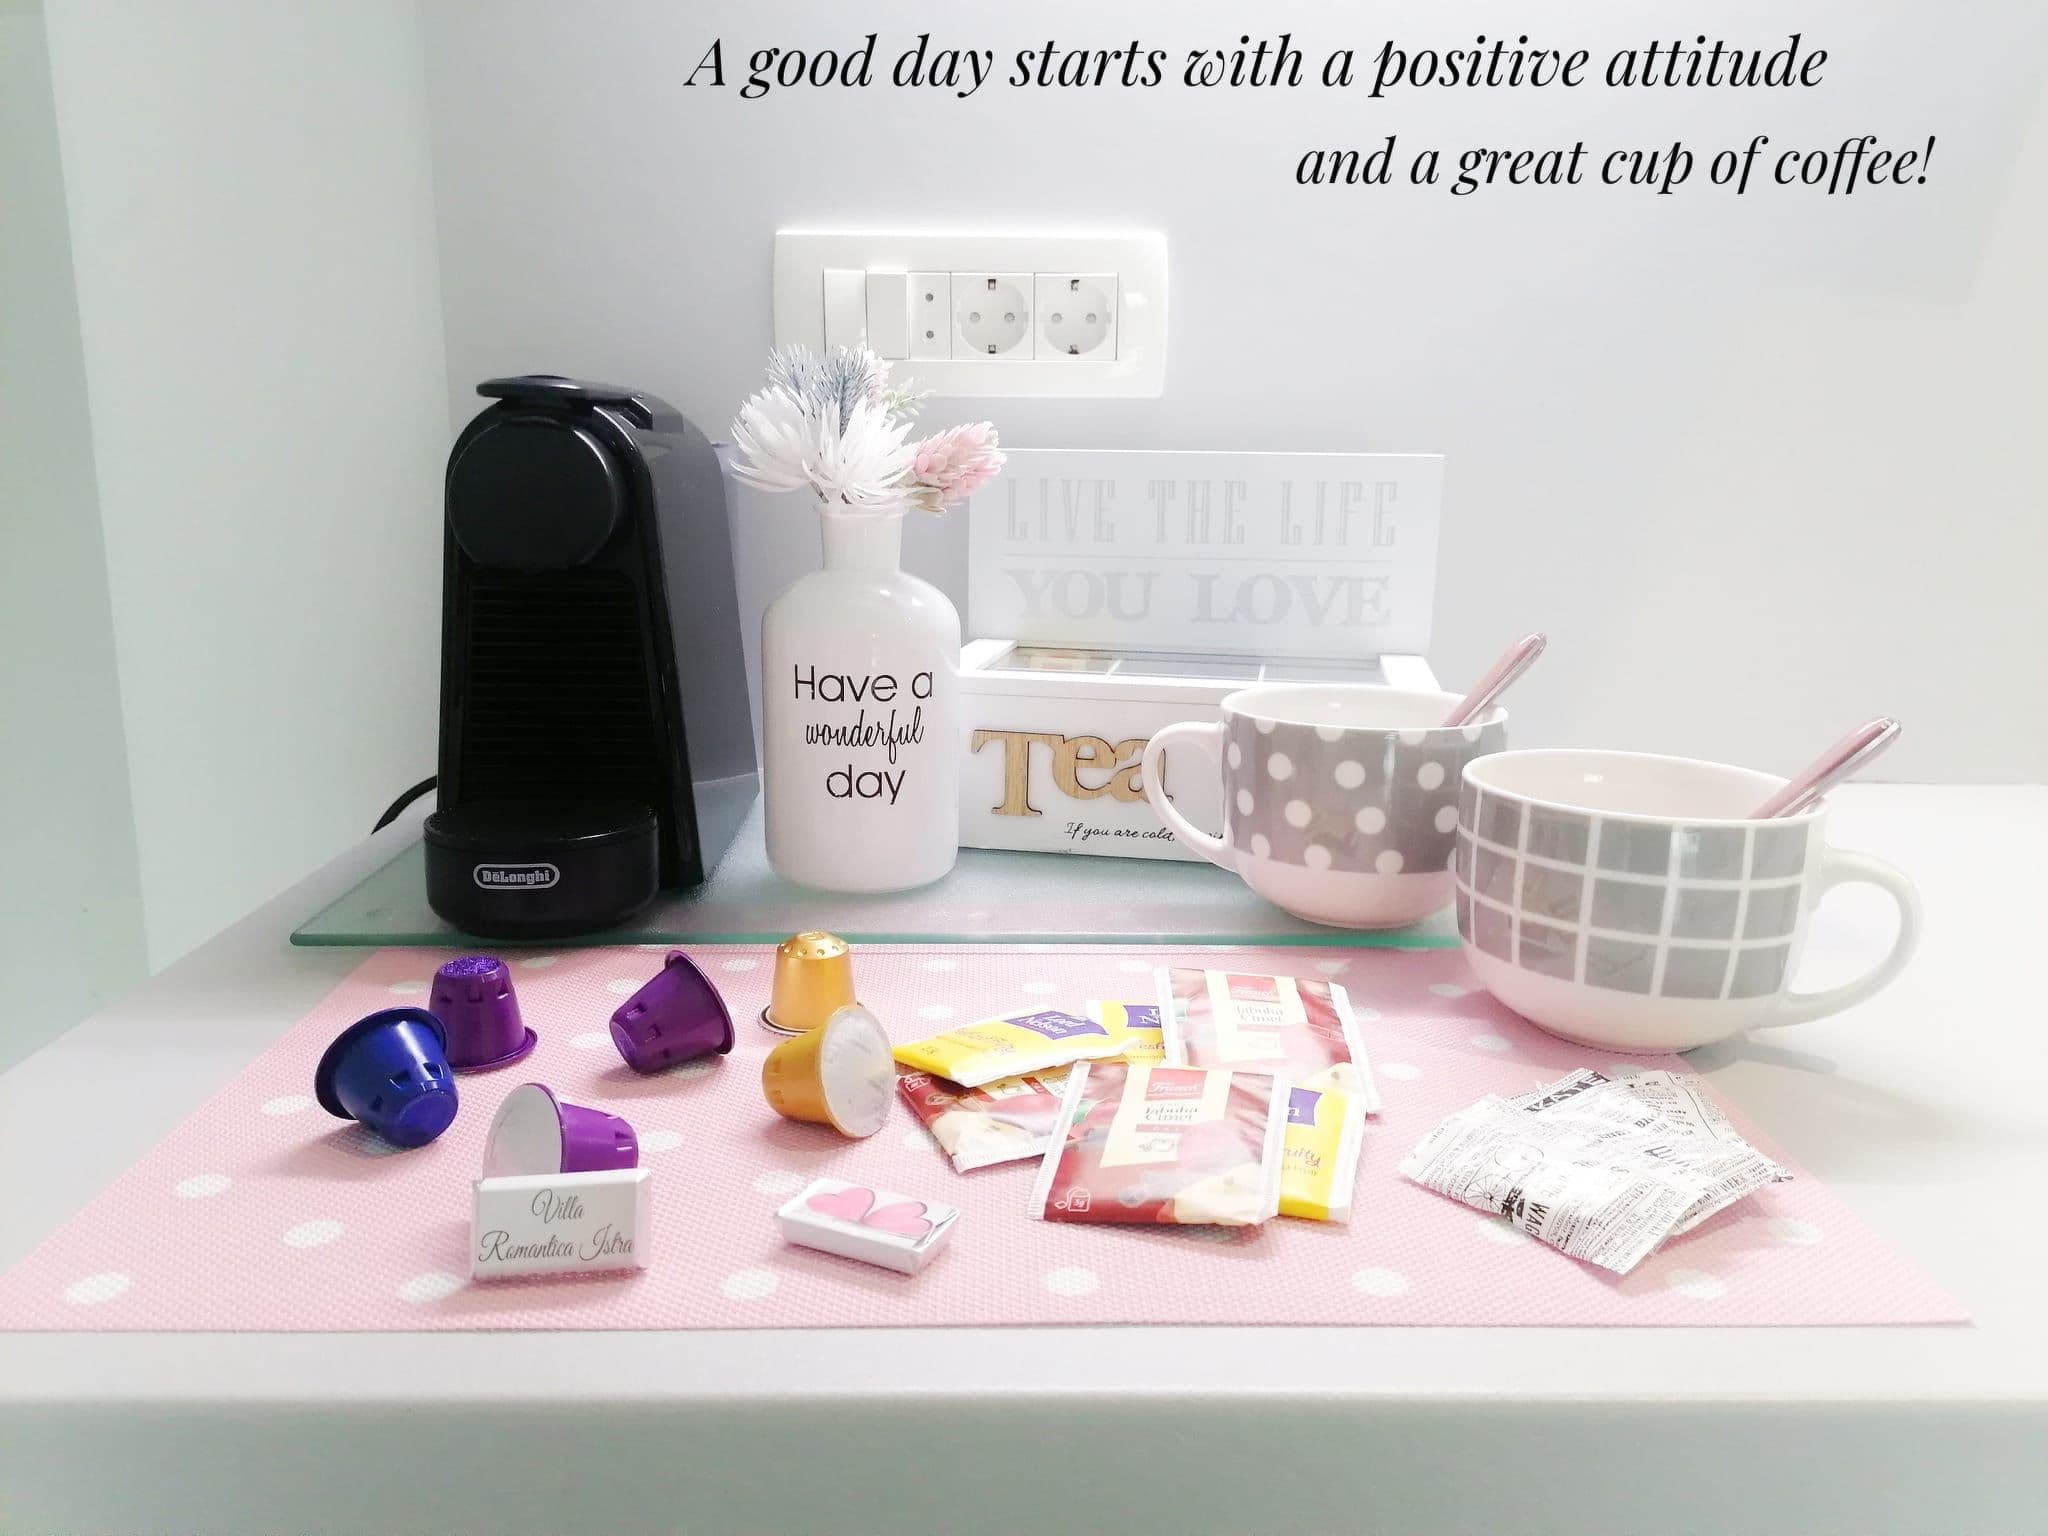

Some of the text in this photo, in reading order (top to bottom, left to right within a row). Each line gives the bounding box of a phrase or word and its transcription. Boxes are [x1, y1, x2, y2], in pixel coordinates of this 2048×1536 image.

[1006, 478, 1397, 546] LIVE THE LIFE
[1005, 569, 1393, 627] YOU LOVE
[794, 663, 933, 702] Have a
[805, 706, 925, 763] wonderful
[826, 764, 906, 805] day
[971, 729, 1174, 817] Tea
[1064, 822, 1083, 840] If
[1082, 828, 1110, 841] you
[1113, 829, 1139, 838] are
[531, 1188, 584, 1224] Villa
[478, 1223, 633, 1262] Romantica Istra
